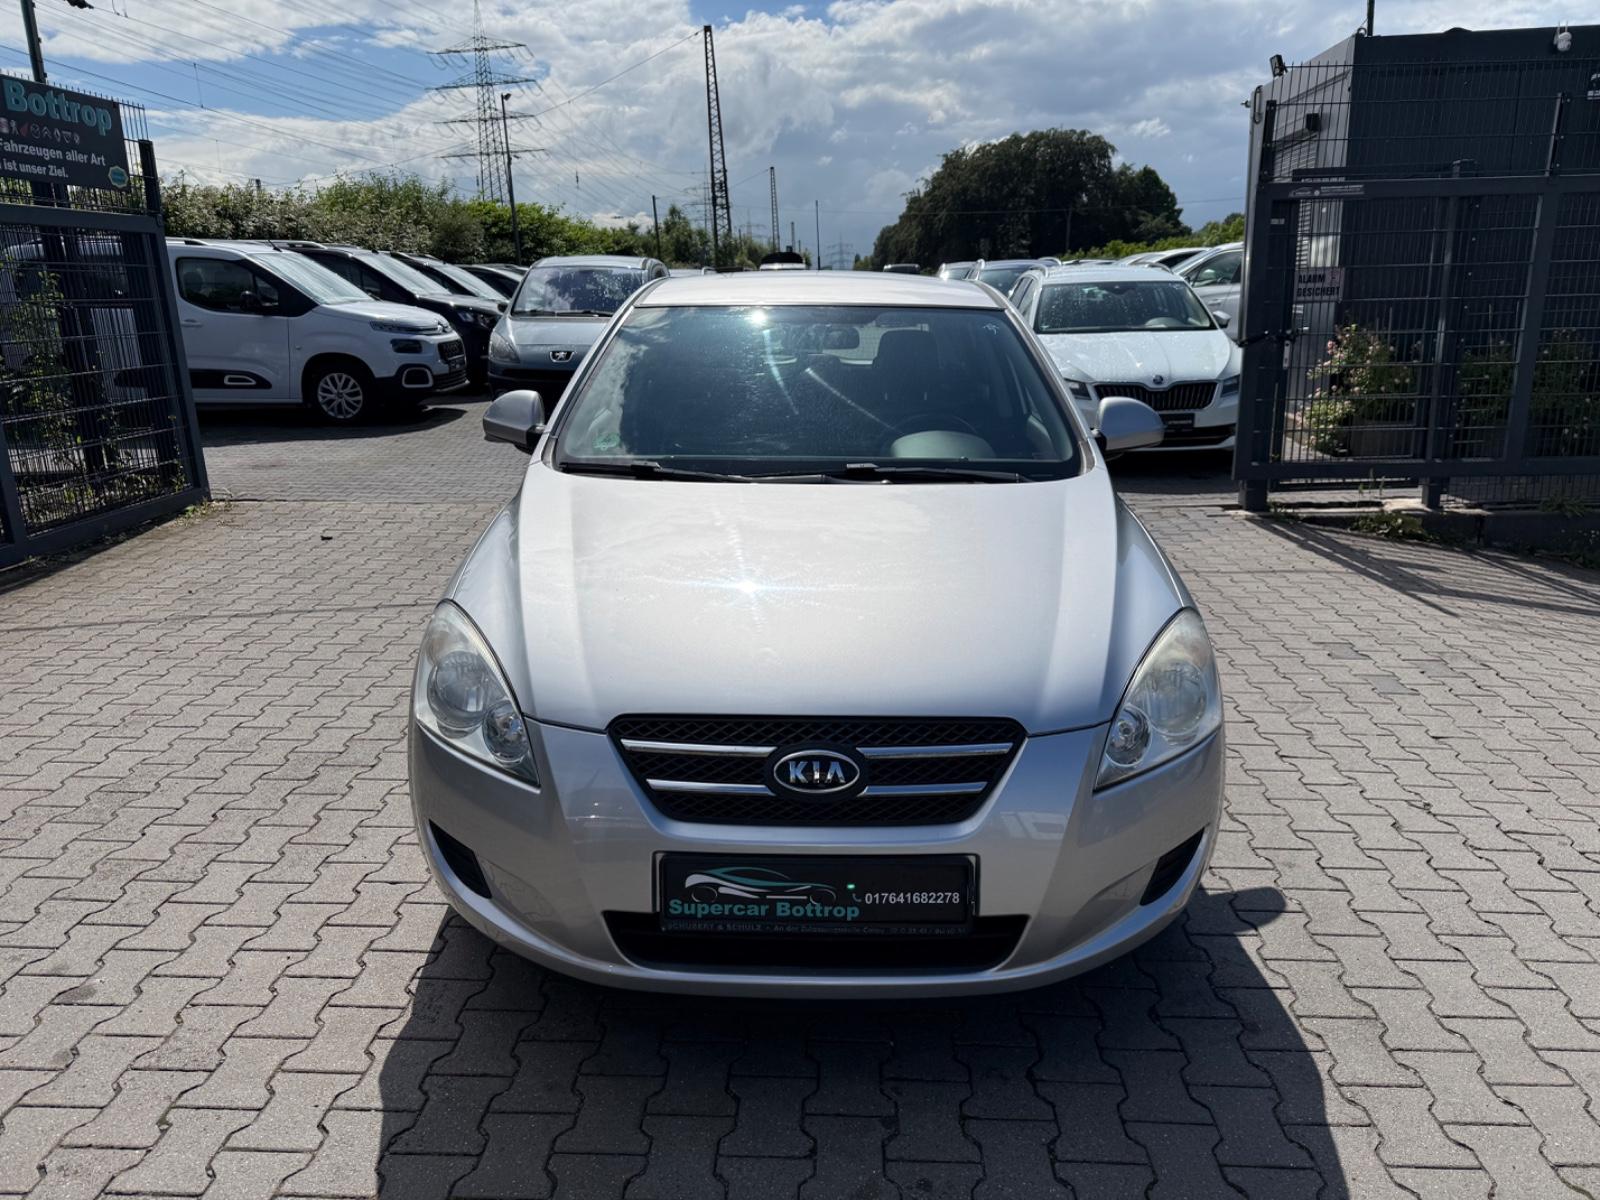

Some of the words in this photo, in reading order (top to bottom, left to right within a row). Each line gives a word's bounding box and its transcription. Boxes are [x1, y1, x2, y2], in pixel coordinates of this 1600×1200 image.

[3, 79, 112, 136] Bottrop
[3, 158, 17, 171] ist
[19, 163, 46, 175] unser
[48, 164, 69, 178] Ziel.
[66, 150, 88, 163] aller
[91, 153, 106, 166] Art
[1298, 274, 1326, 283] ALARM
[789, 761, 846, 783] KIA
[865, 892, 960, 904] 017641682278
[668, 899, 769, 918] Supercar
[776, 902, 860, 921] Bottrop
